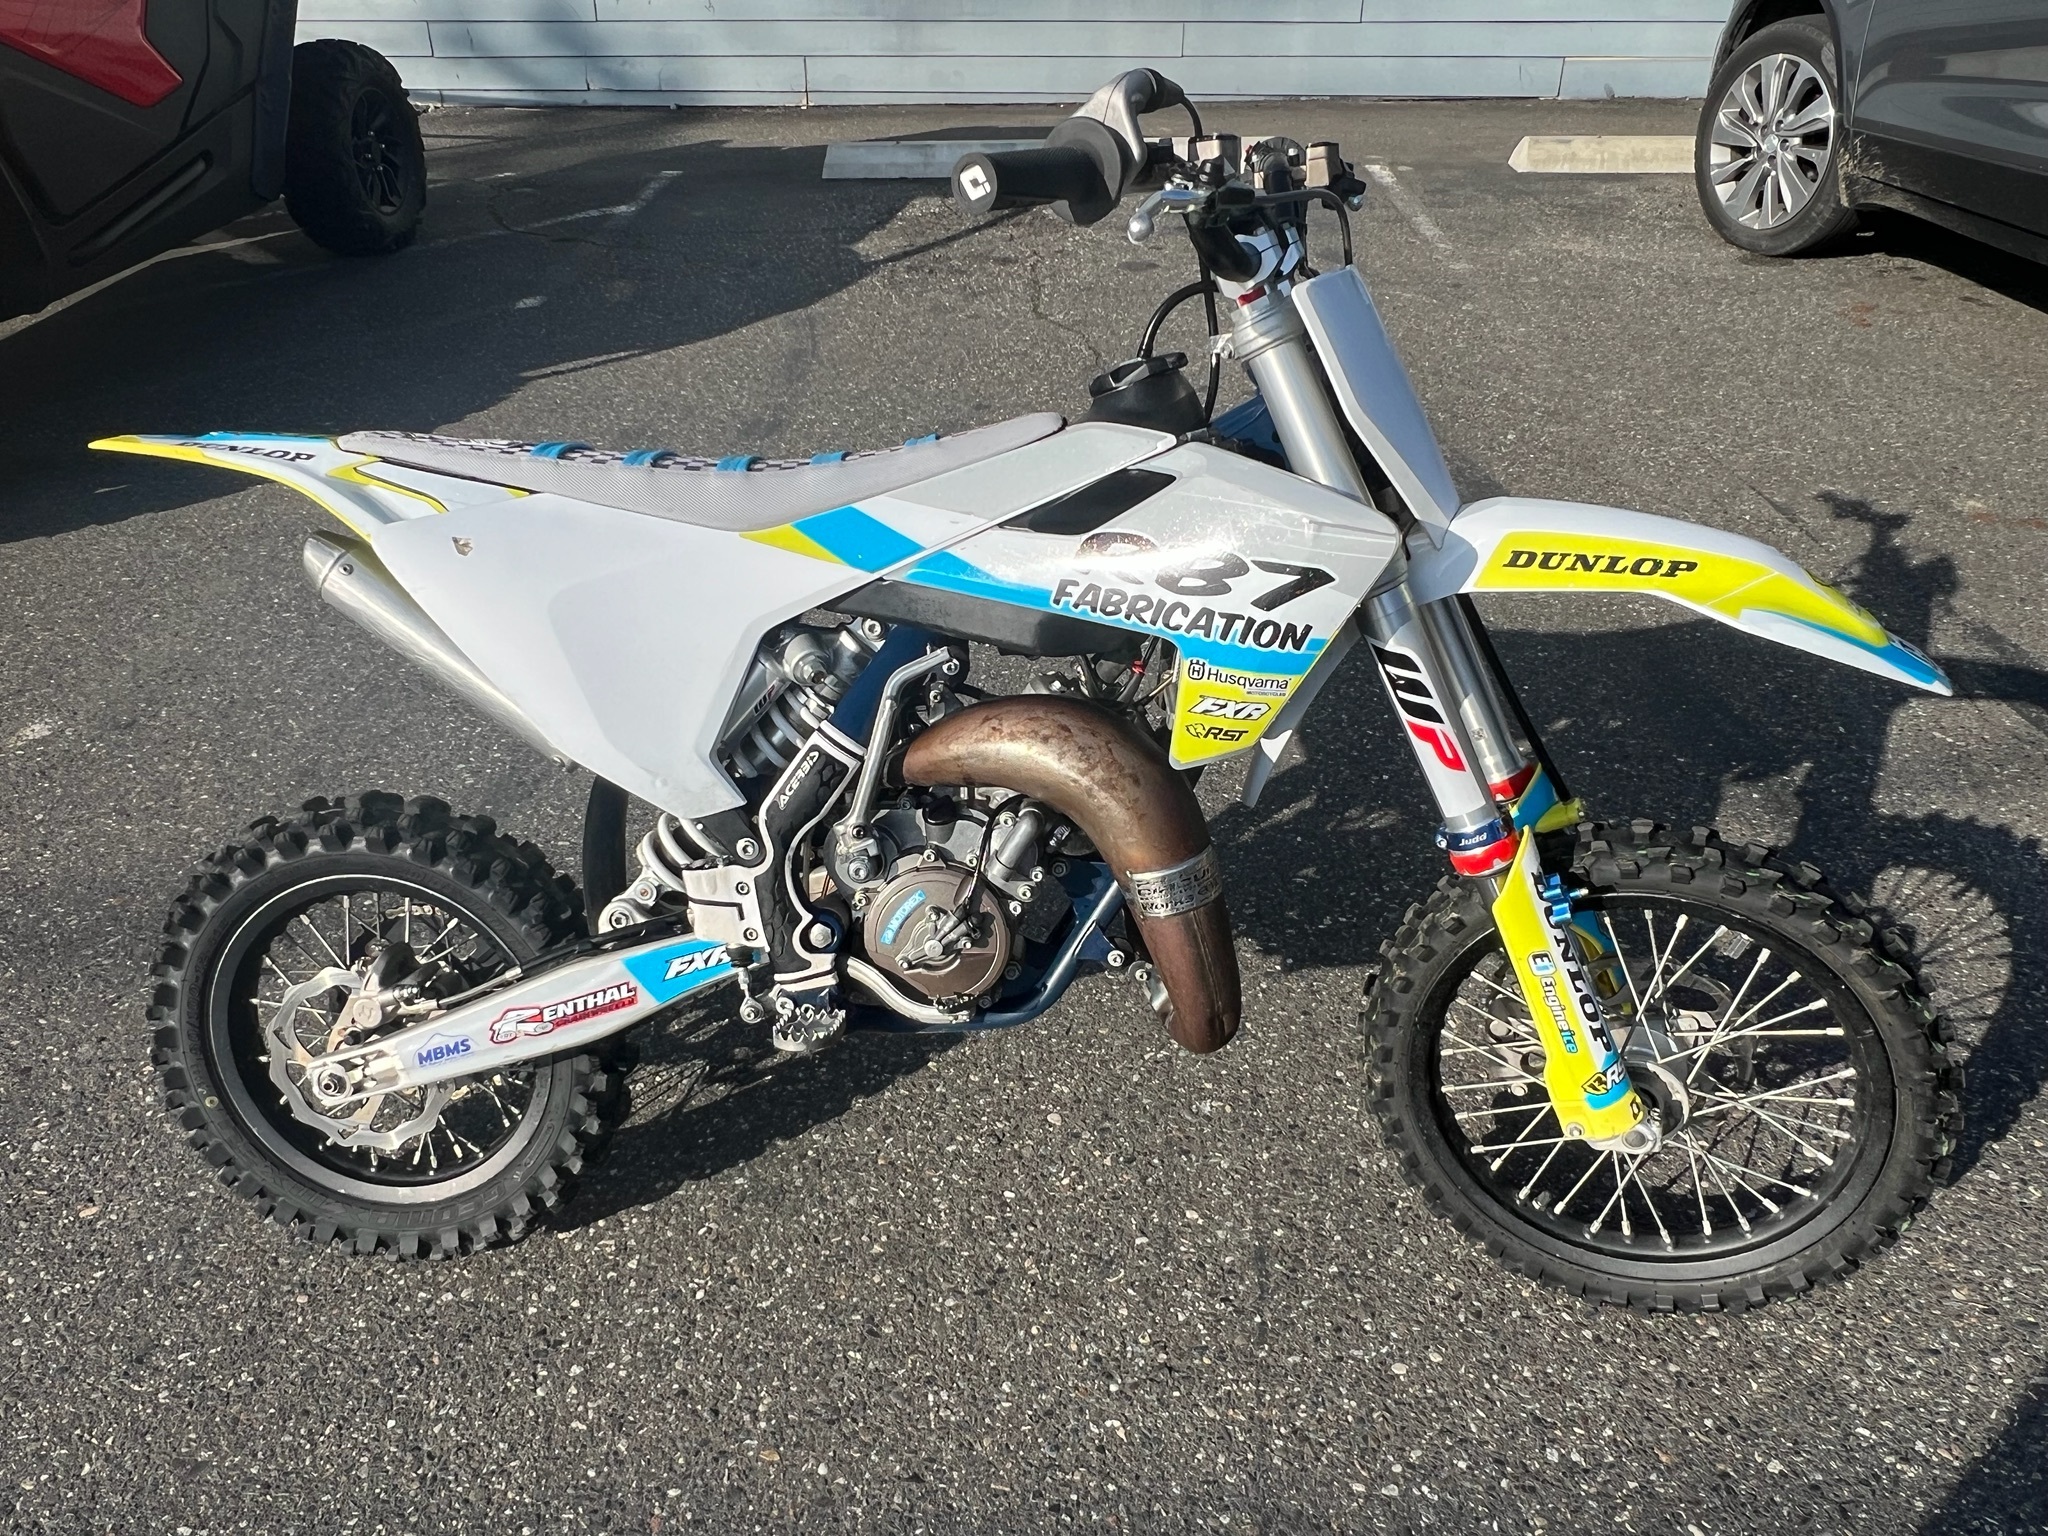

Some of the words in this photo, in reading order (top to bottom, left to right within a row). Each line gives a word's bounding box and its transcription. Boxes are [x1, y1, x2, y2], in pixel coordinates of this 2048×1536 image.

[1502, 550, 1698, 577] DUNLOP
[1053, 579, 1313, 652] FABRICATION
[1207, 668, 1289, 689] Husqvarna
[1188, 696, 1271, 720] FXR
[1371, 643, 1467, 772] WP
[1203, 727, 1249, 742] RST
[779, 750, 820, 810] ACERBIS
[662, 944, 731, 981] FXR
[418, 1038, 471, 1065] MBMS
